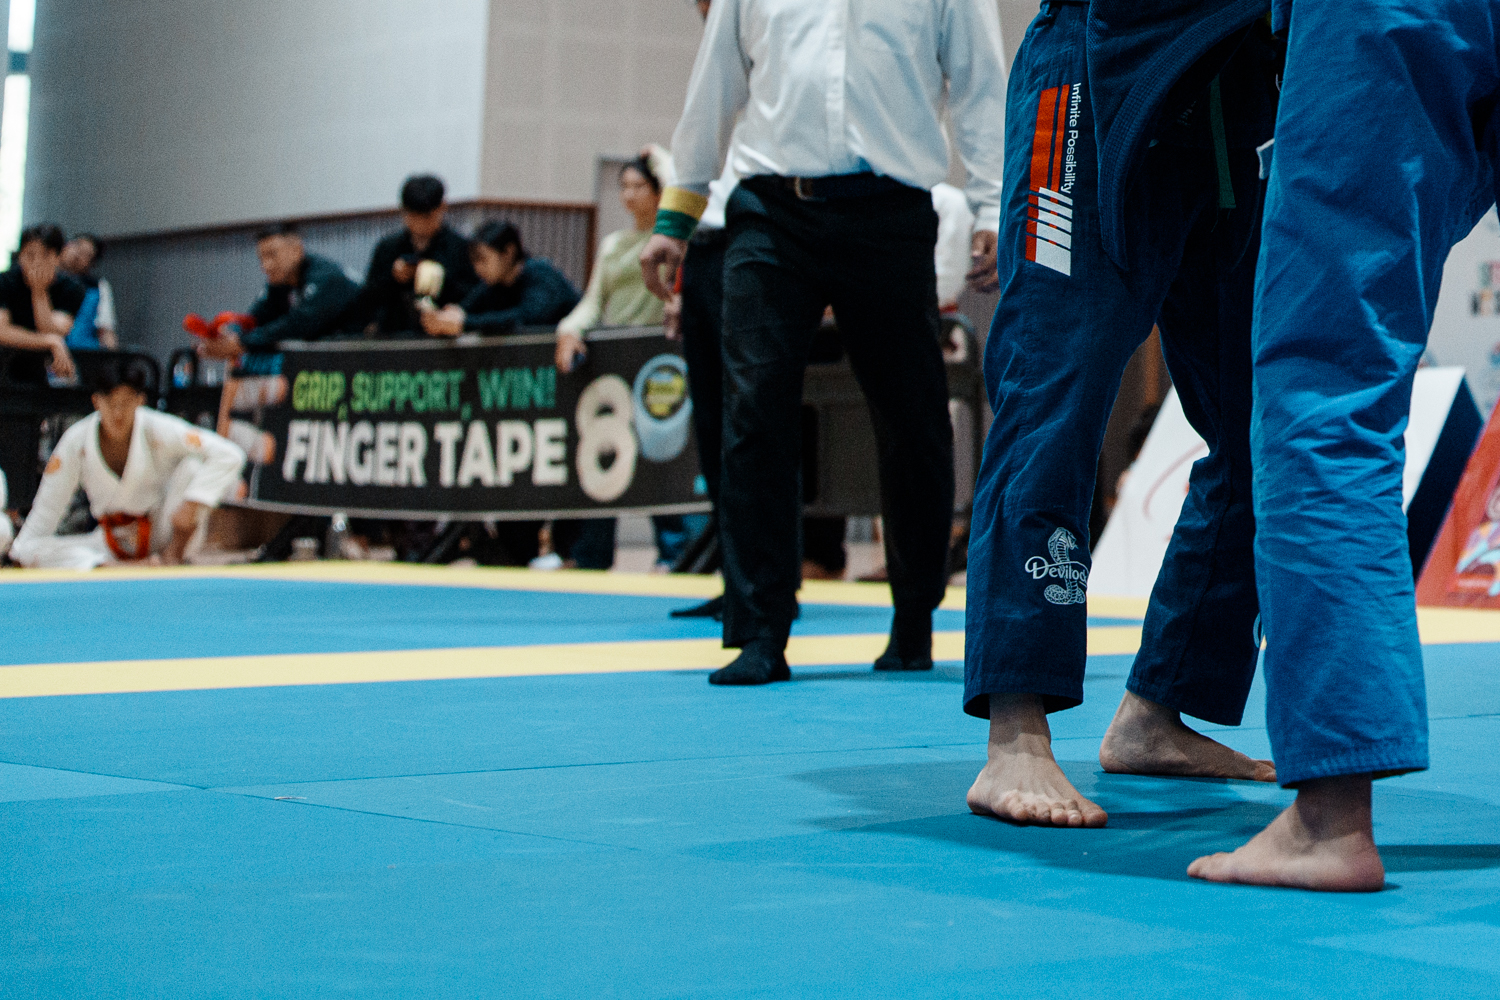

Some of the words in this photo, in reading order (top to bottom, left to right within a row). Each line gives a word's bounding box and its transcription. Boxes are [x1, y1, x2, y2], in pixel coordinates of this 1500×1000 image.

[1069, 82, 1082, 128] Infinite
[1060, 130, 1079, 195] Possibility
[351, 371, 473, 419] SUPPORT,
[476, 366, 557, 411] WIN!
[283, 419, 428, 487] FINGER
[434, 417, 569, 487] TAPE
